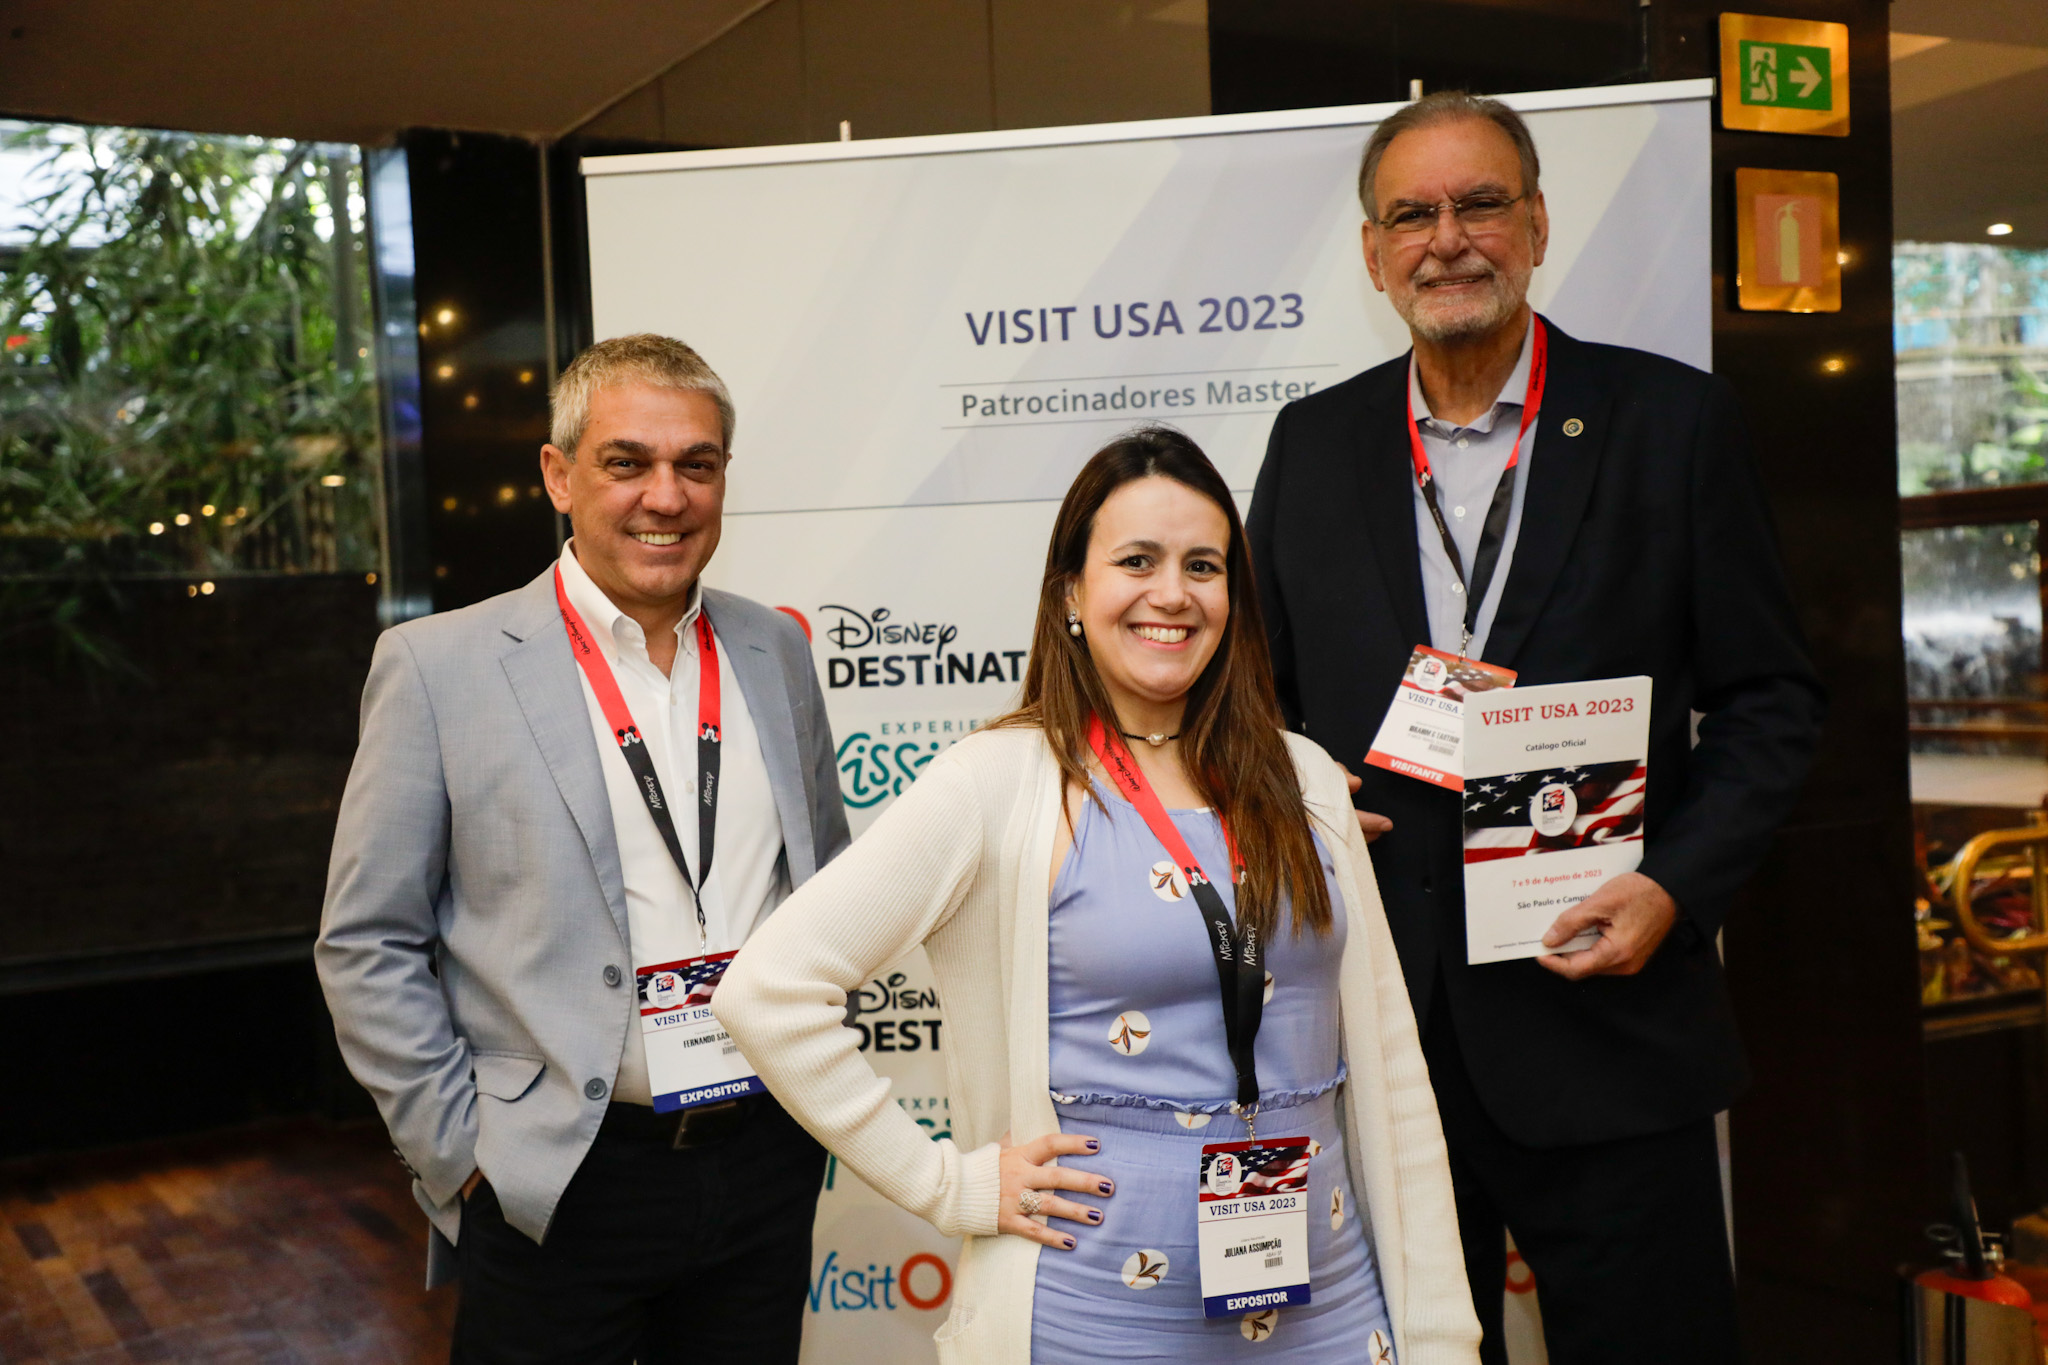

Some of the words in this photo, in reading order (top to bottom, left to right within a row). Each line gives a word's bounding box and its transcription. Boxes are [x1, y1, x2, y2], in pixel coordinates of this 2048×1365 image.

[965, 306, 1077, 346] VISIT
[1093, 300, 1184, 339] USA
[1198, 293, 1305, 334] 2023
[962, 384, 1196, 417] Patrocinadores
[1207, 379, 1317, 406] Master
[1408, 691, 1436, 707] VISIT
[1438, 701, 1459, 714] USA
[1481, 707, 1533, 726] VISIT
[1540, 703, 1579, 719] USA
[1586, 697, 1634, 716] 2023
[881, 719, 978, 735] EXPERIE
[1525, 741, 1560, 753] Catálogo
[1561, 738, 1587, 748] Oficial
[1390, 758, 1444, 783] VISITANTE
[1532, 877, 1542, 885] de
[1543, 874, 1571, 885] Agosto
[1573, 871, 1582, 879] de
[1584, 869, 1602, 878] 2023
[1517, 901, 1531, 910] São
[1533, 898, 1554, 908] Paulo
[654, 1012, 689, 1027] VISIT
[683, 1034, 716, 1048] FERNANDO
[716, 1031, 730, 1041] SAN
[679, 1080, 750, 1104] EXPOSITOR
[1209, 1203, 1241, 1216] VISIT
[1244, 1201, 1266, 1213] USA
[1269, 1197, 1296, 1210] 2023
[1224, 1245, 1248, 1258] JULIANA
[1226, 1291, 1289, 1310] EXPOSITOR
